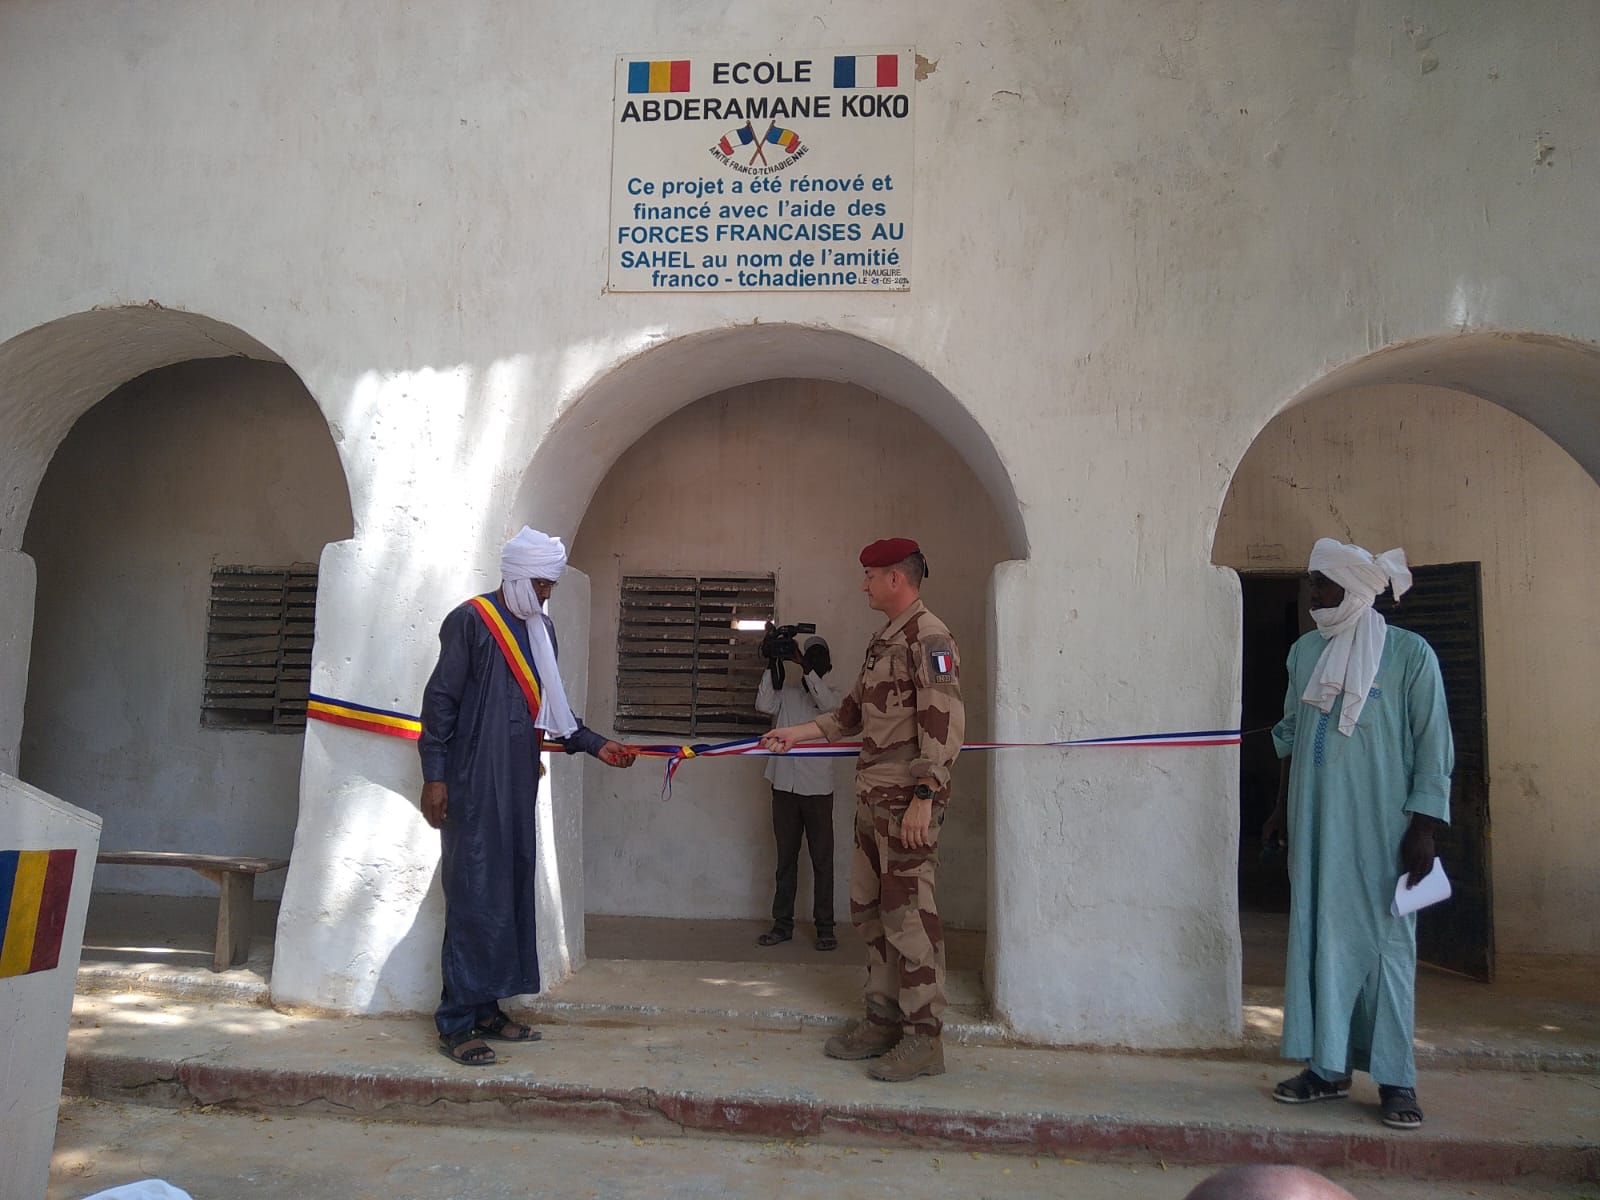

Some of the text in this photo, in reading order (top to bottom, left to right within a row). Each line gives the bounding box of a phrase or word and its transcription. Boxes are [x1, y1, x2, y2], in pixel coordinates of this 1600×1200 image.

[713, 60, 812, 84] ECOLE
[620, 95, 909, 122] ABDERAMANE KOKO
[709, 144, 809, 175] AMITIÉ FRANCO-TCHADIENNE
[627, 175, 893, 198] Ce projet a été rénové et
[634, 200, 710, 219] financé
[719, 203, 768, 218] avec
[848, 199, 886, 216] des
[618, 223, 904, 244] FORCES FRANCAISES AU
[621, 251, 694, 268] SAHEL
[703, 255, 727, 267] au
[737, 254, 782, 267] nom
[790, 250, 814, 266] de
[652, 270, 719, 287] franco
[738, 270, 856, 286] tchadienne
